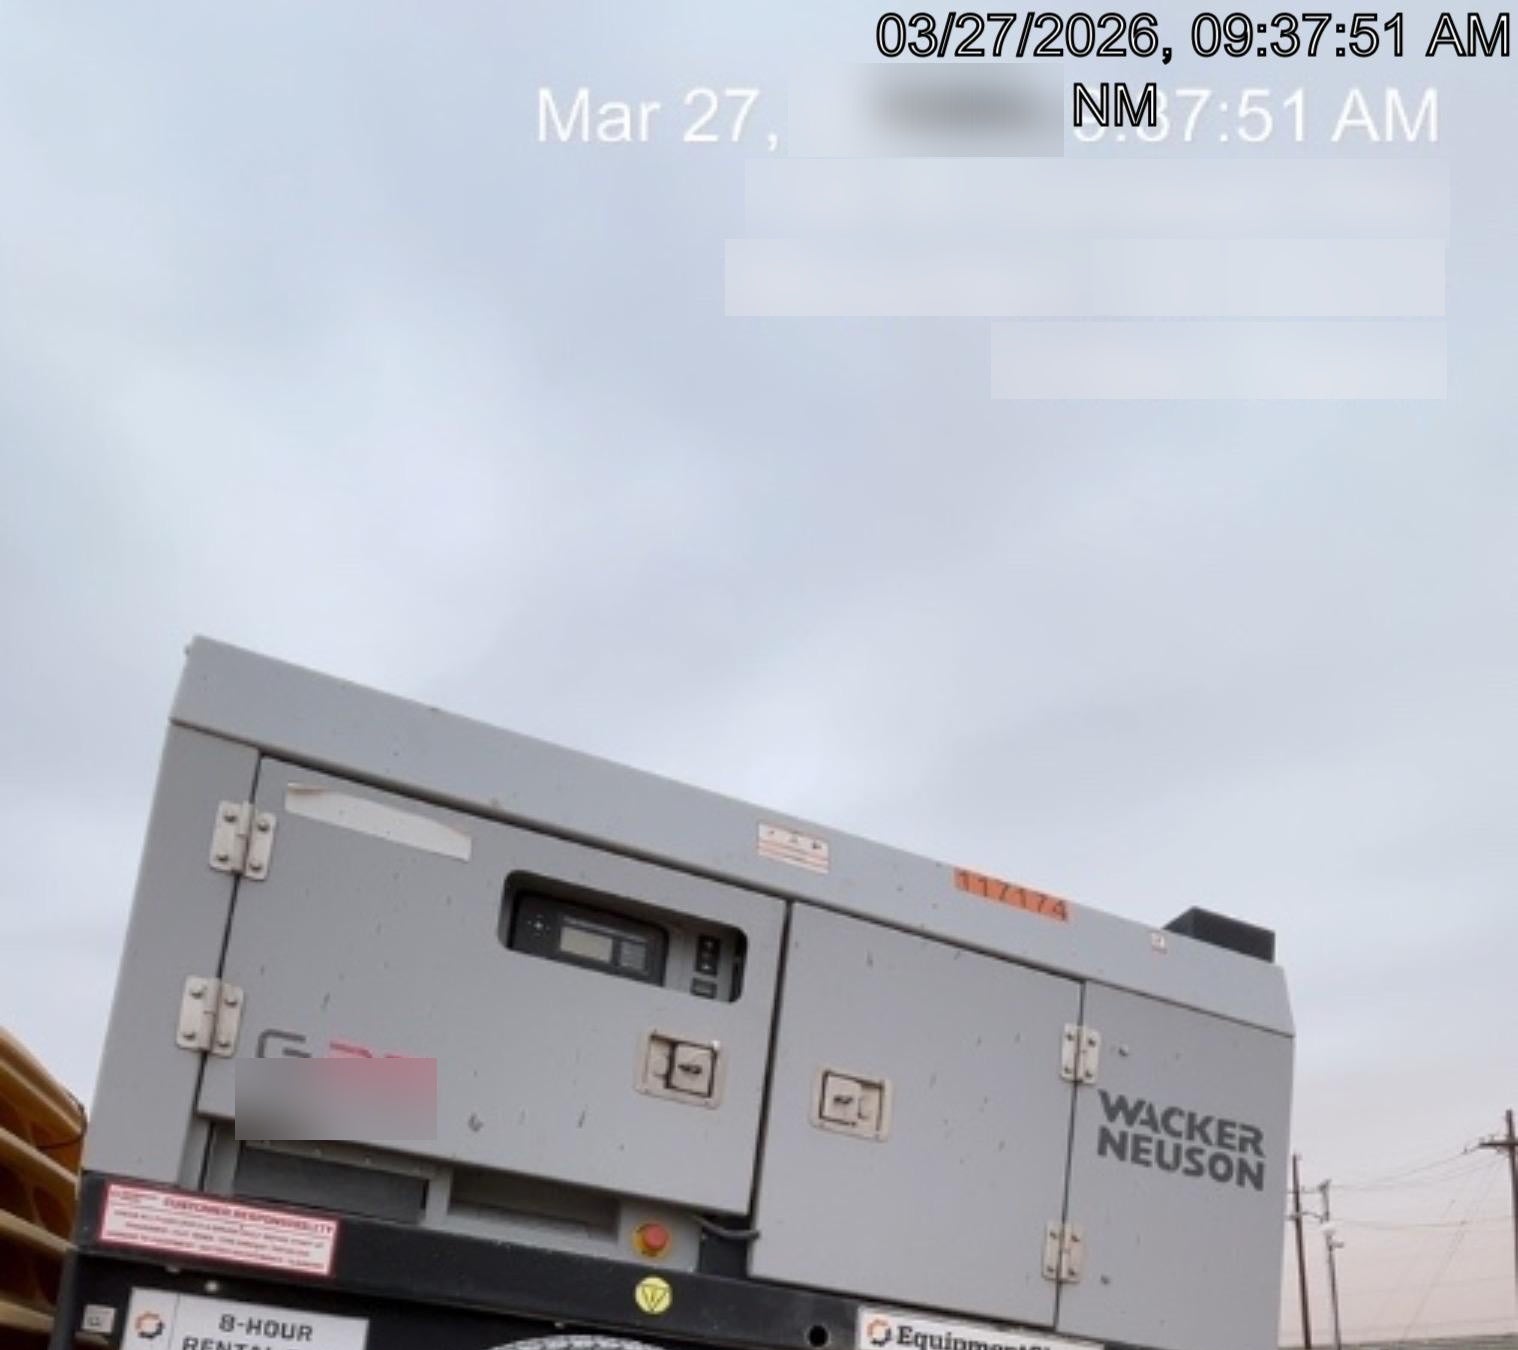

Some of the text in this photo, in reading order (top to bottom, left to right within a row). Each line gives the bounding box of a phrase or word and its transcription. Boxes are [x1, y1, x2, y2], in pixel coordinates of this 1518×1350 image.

[957, 867, 1067, 921] 117174
[1098, 1088, 1265, 1158] WACKER
[1098, 1125, 1264, 1191] NEUSON
[218, 1313, 313, 1342] 8-HOUR
